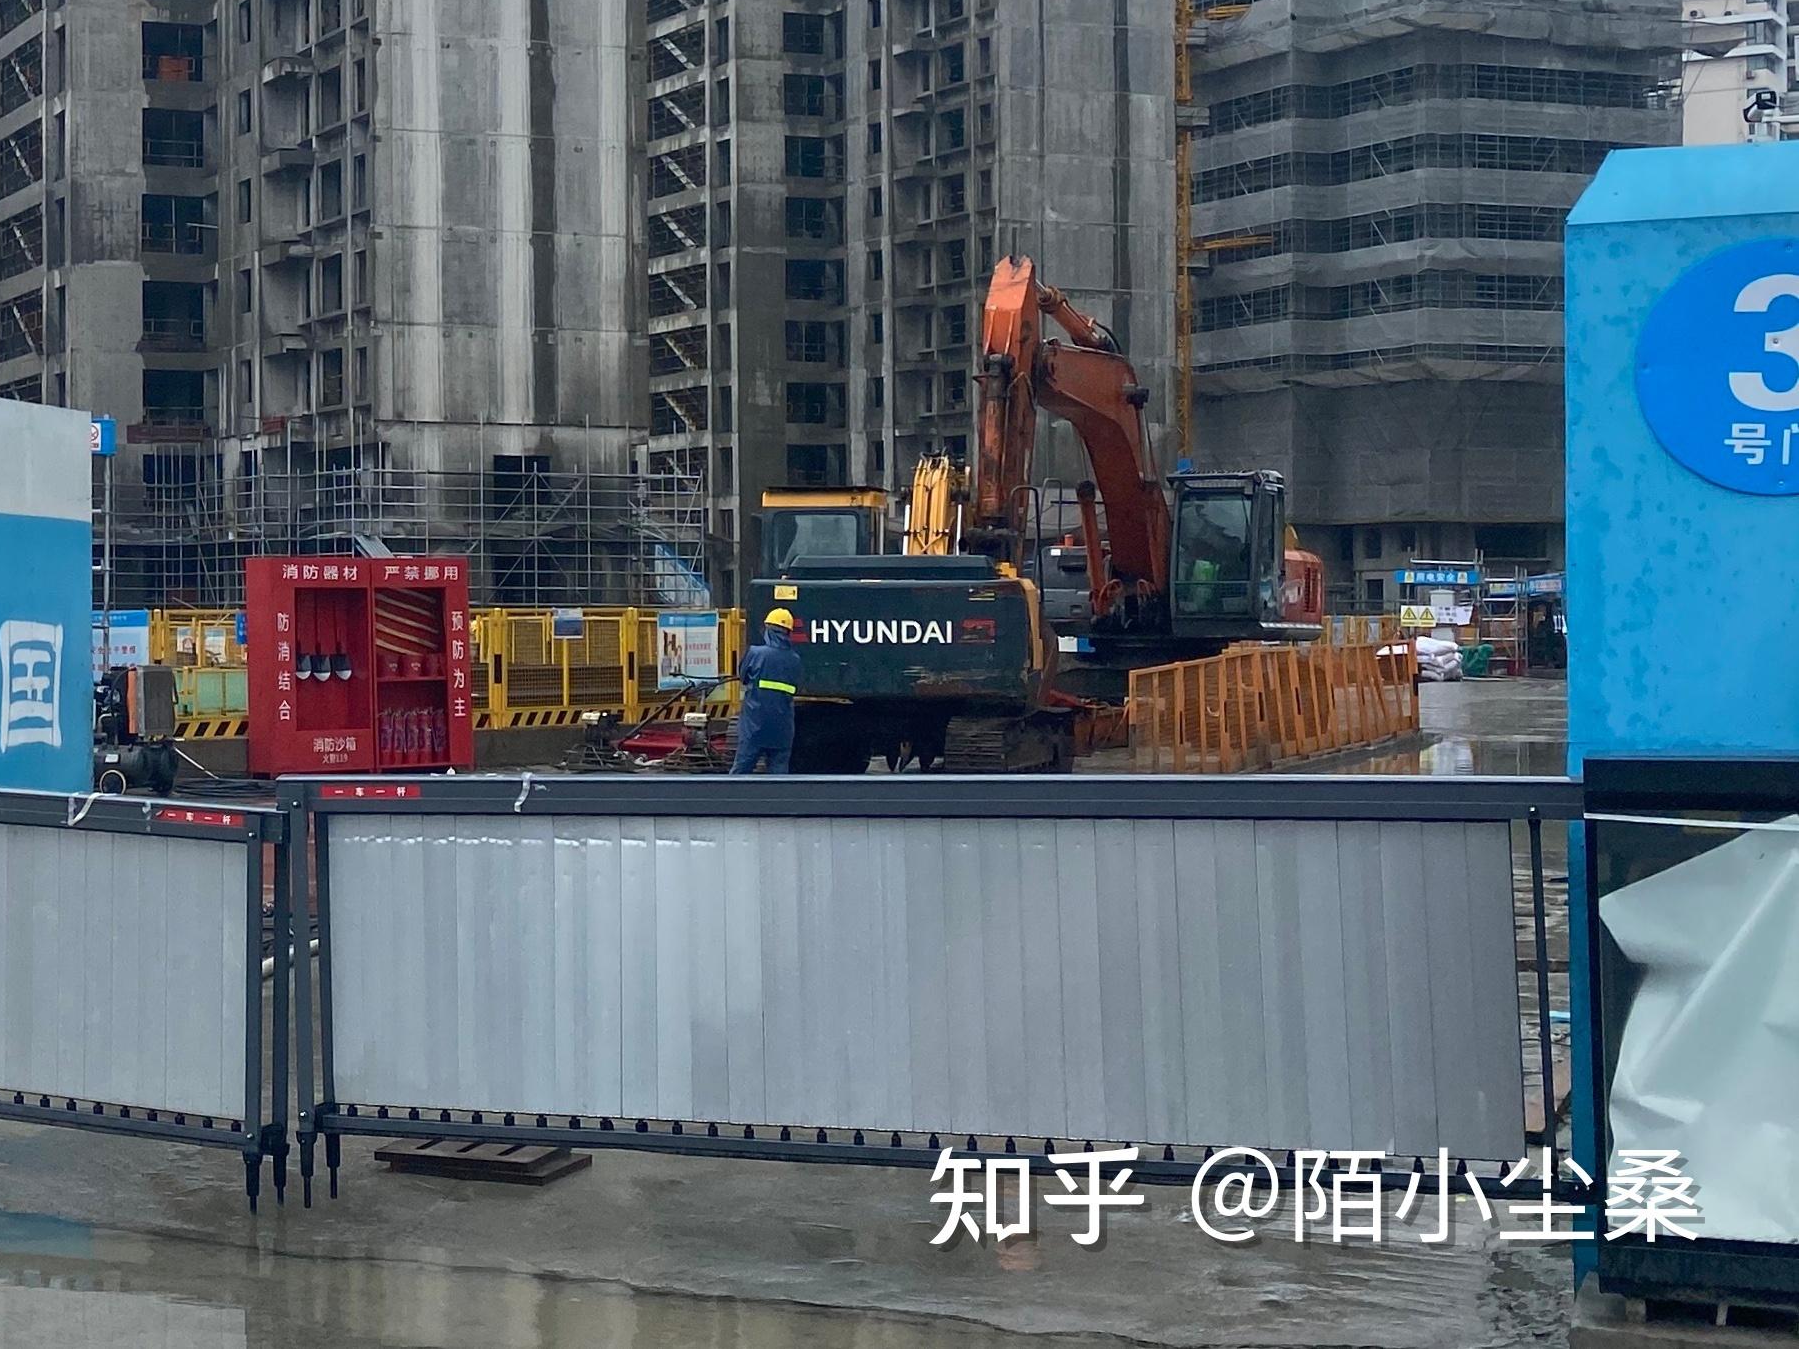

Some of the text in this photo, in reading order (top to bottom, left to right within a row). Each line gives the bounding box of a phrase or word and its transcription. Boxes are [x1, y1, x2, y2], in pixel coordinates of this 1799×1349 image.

[1729, 273, 1799, 412] 3
[282, 564, 459, 580] 消防器材 严禁挪用
[810, 619, 953, 644] HYUNDAI
[276, 612, 291, 721] 防消结合
[451, 611, 466, 717] 预防为主
[334, 786, 407, 798] 一车一杆
[167, 811, 232, 825] 一车一杆
